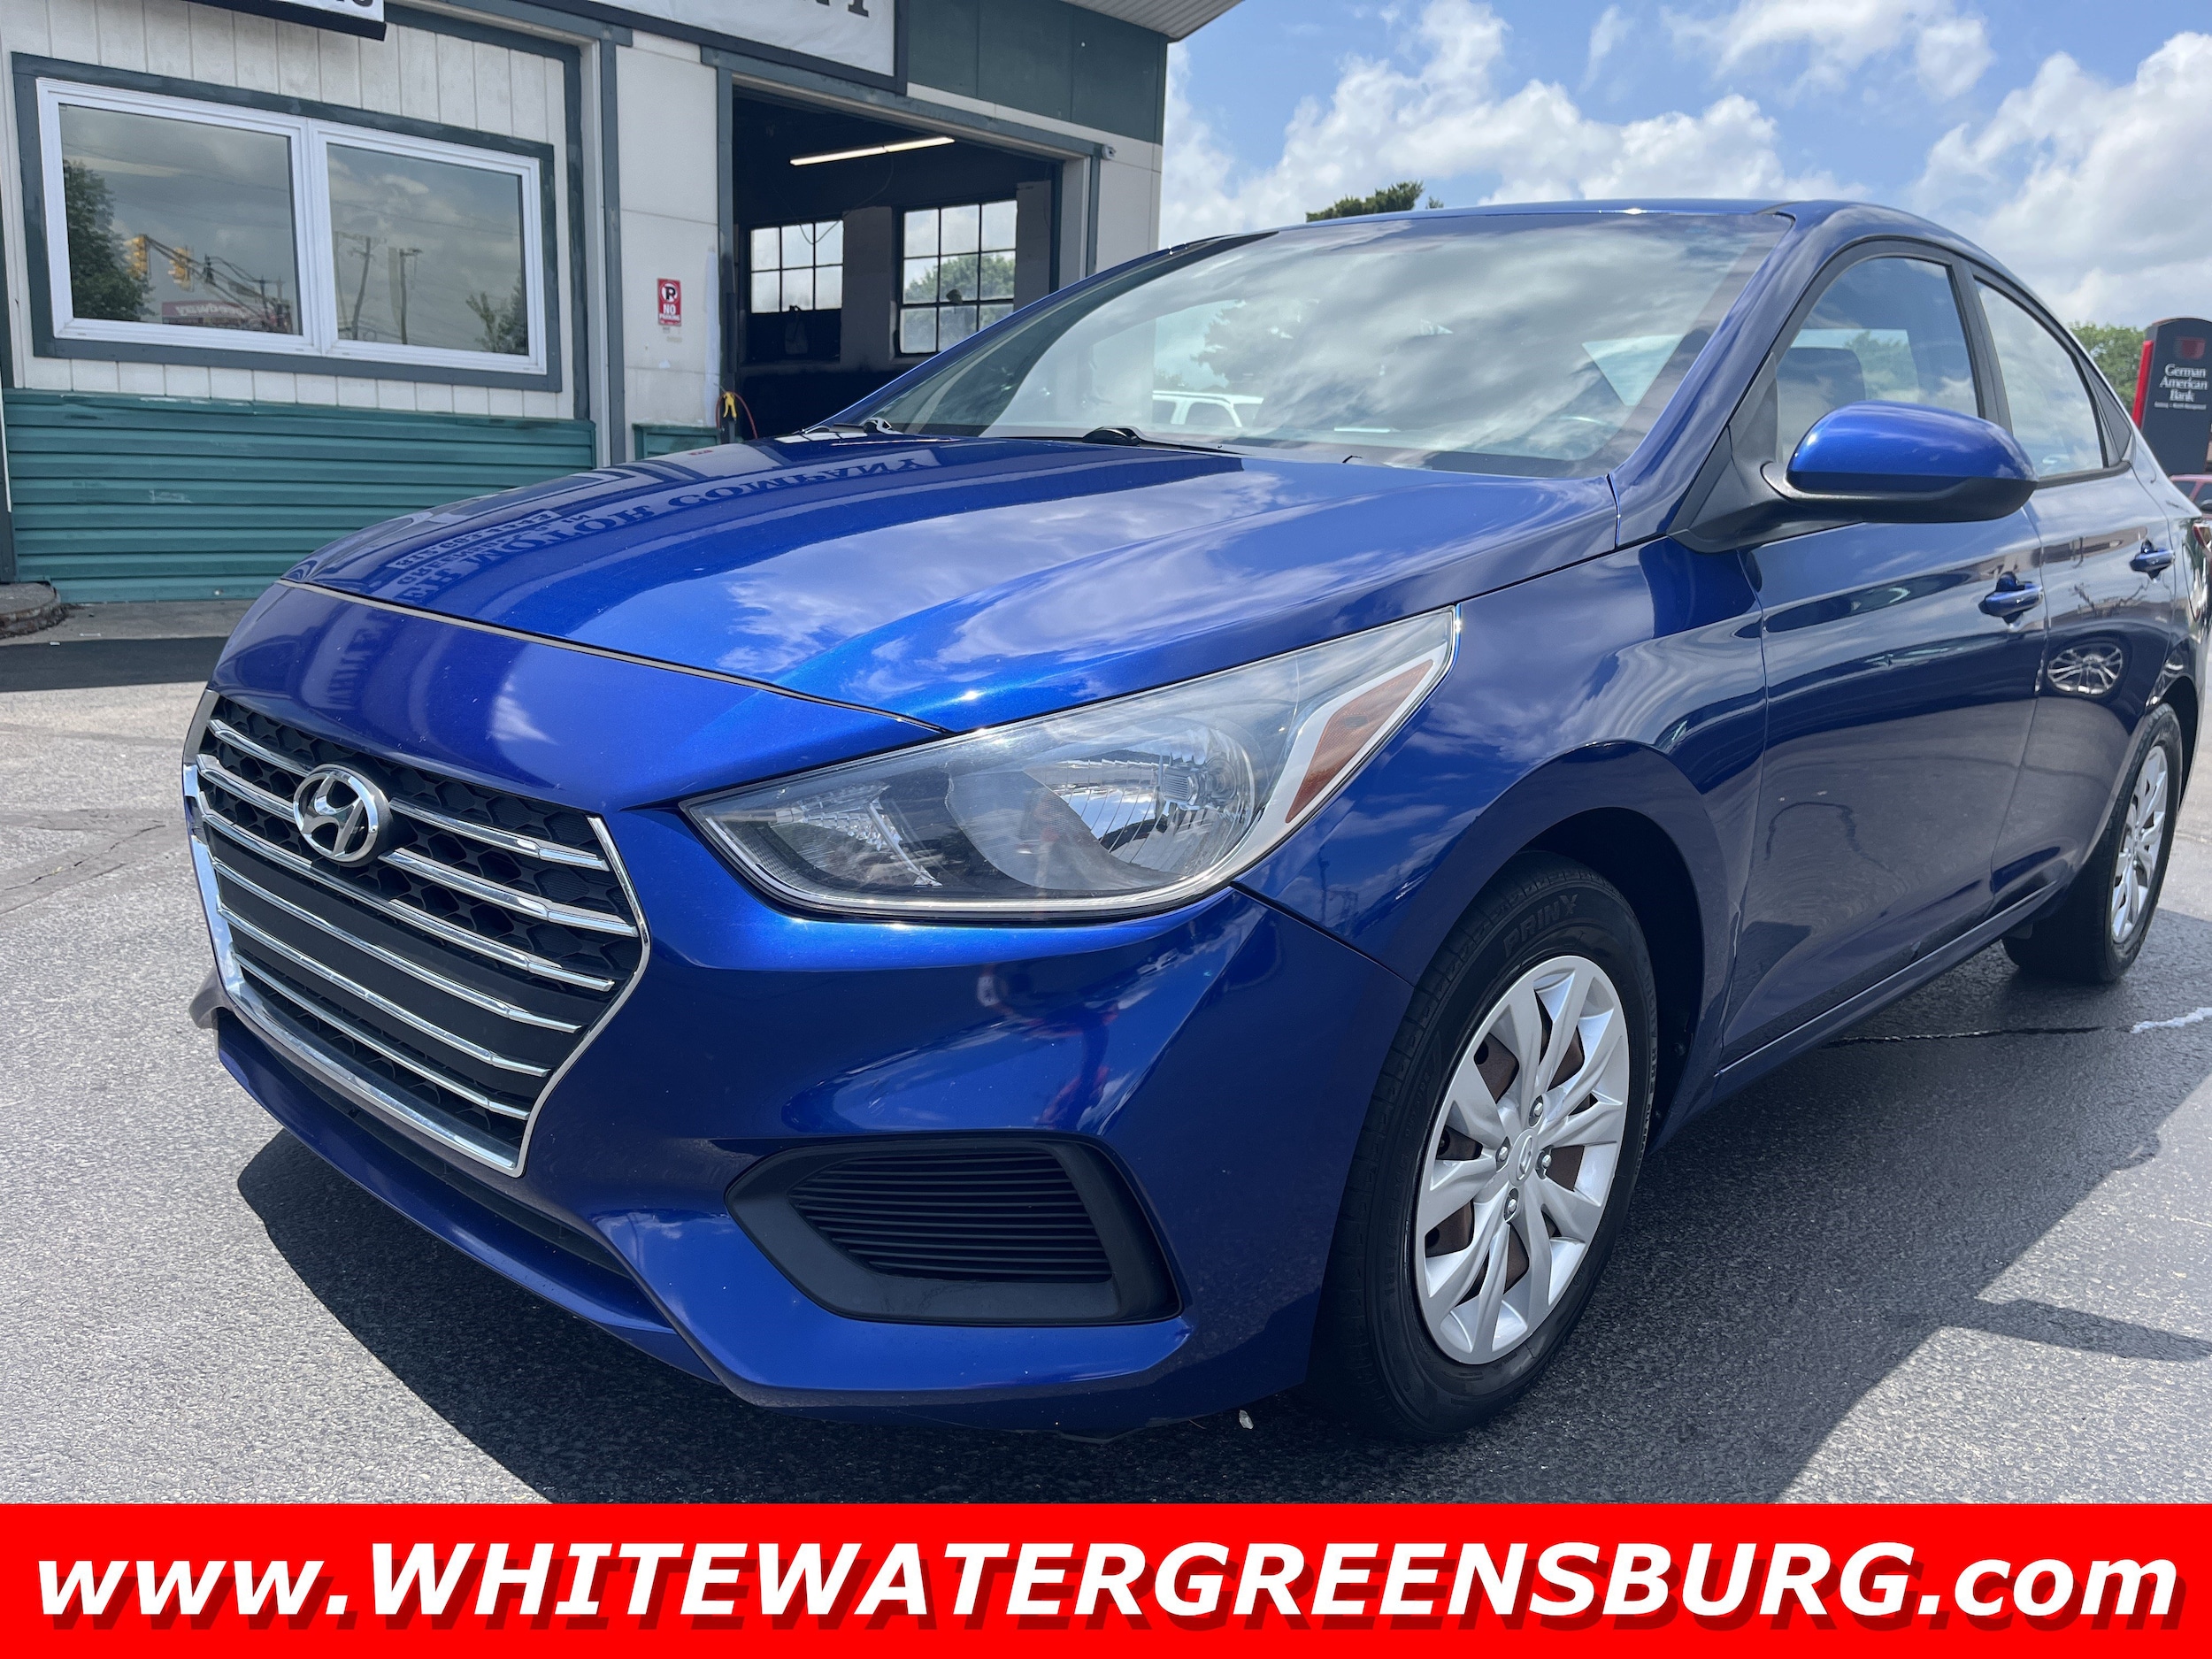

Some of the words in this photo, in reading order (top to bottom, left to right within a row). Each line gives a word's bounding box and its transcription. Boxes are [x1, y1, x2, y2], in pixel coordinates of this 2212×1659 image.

[663, 303, 676, 315] NO
[2164, 363, 2206, 378] German
[2159, 375, 2208, 390] American
[2170, 388, 2194, 403] Bank
